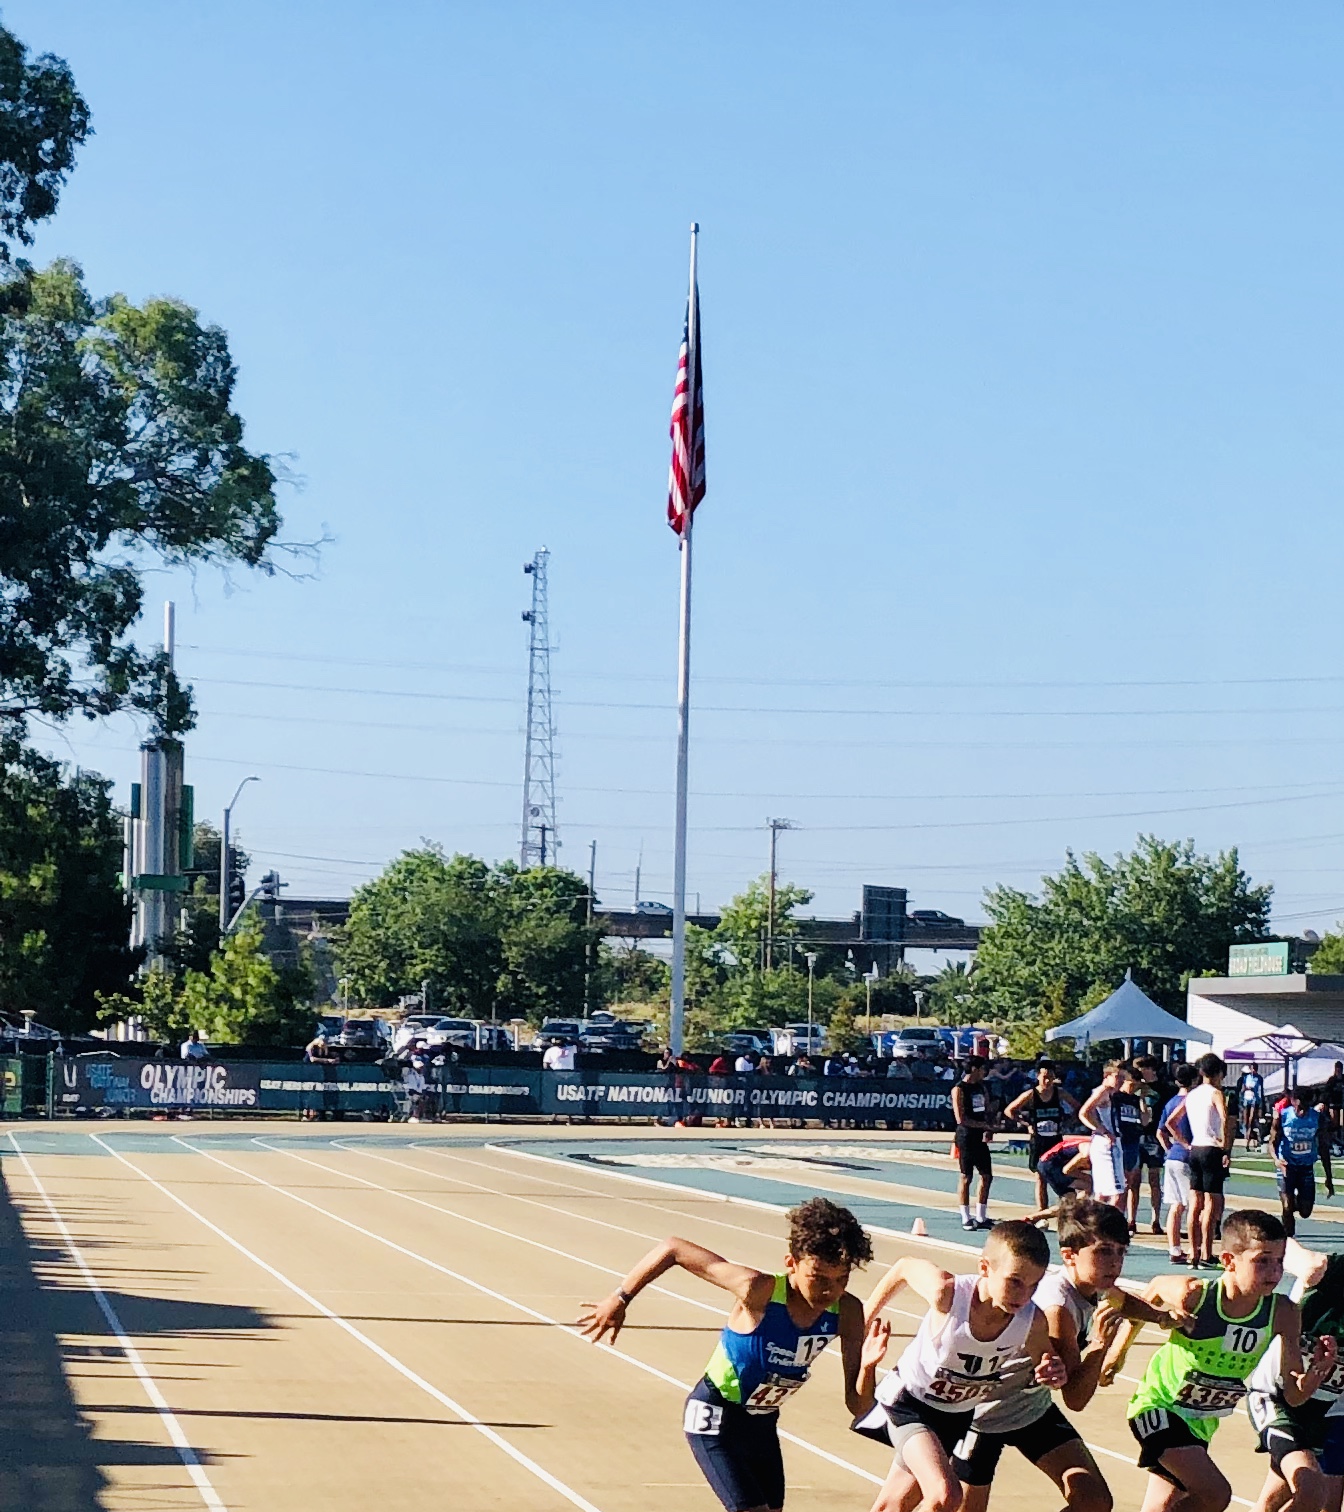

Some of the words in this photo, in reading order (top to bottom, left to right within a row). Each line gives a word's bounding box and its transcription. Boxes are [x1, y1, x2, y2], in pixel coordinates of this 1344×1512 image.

[140, 1063, 227, 1090] OLYMPIC
[150, 1088, 256, 1105] CHAMPIONSHIPS
[557, 1084, 606, 1101] USATF
[607, 1085, 683, 1102] NATIONAL
[686, 1088, 746, 1104] JUNIOR
[750, 1089, 818, 1106] OLYMPIC
[822, 1091, 954, 1109] CHAMPIONSHIPS
[1232, 1327, 1258, 1354] 10
[751, 1386, 800, 1405] 43
[692, 1404, 714, 1432] 13
[1138, 1407, 1161, 1434] 10
